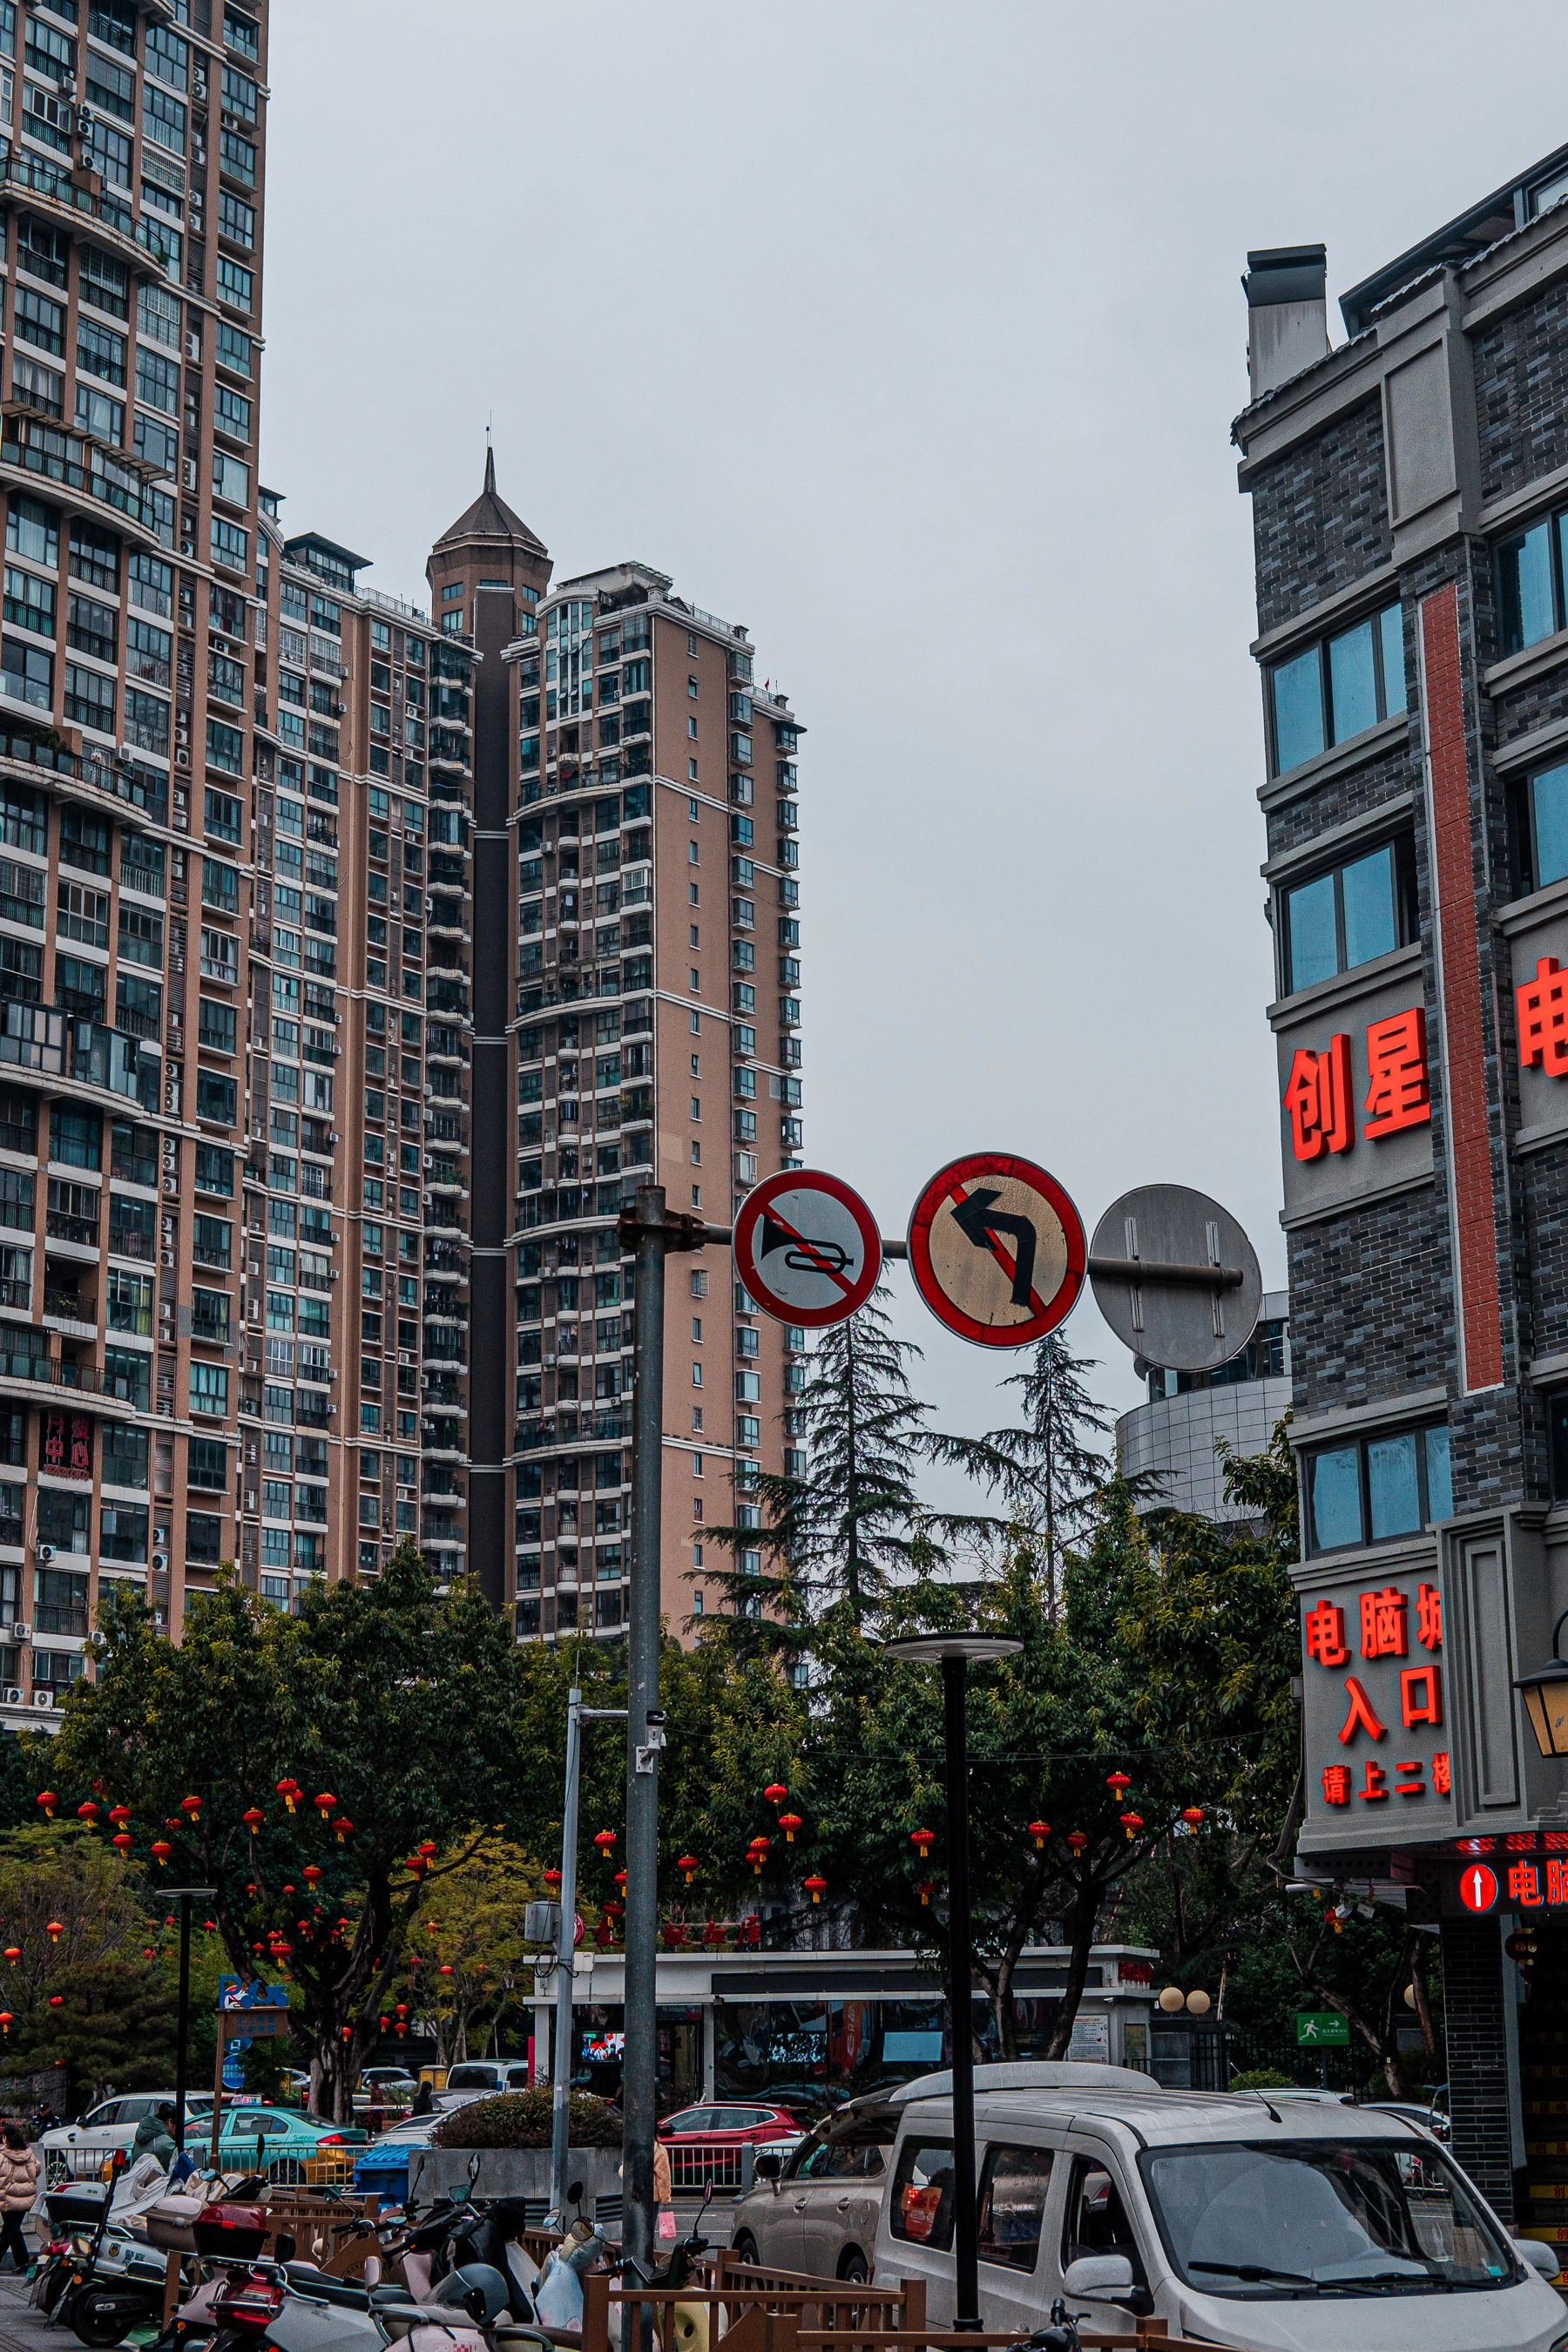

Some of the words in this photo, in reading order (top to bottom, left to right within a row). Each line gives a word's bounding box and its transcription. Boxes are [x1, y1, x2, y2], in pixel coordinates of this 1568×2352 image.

[1282, 1007, 1431, 1162] 创星
[45, 1436, 90, 1468] 中心
[1337, 1665, 1443, 1745] 入口
[124, 2248, 145, 2261] 警察
